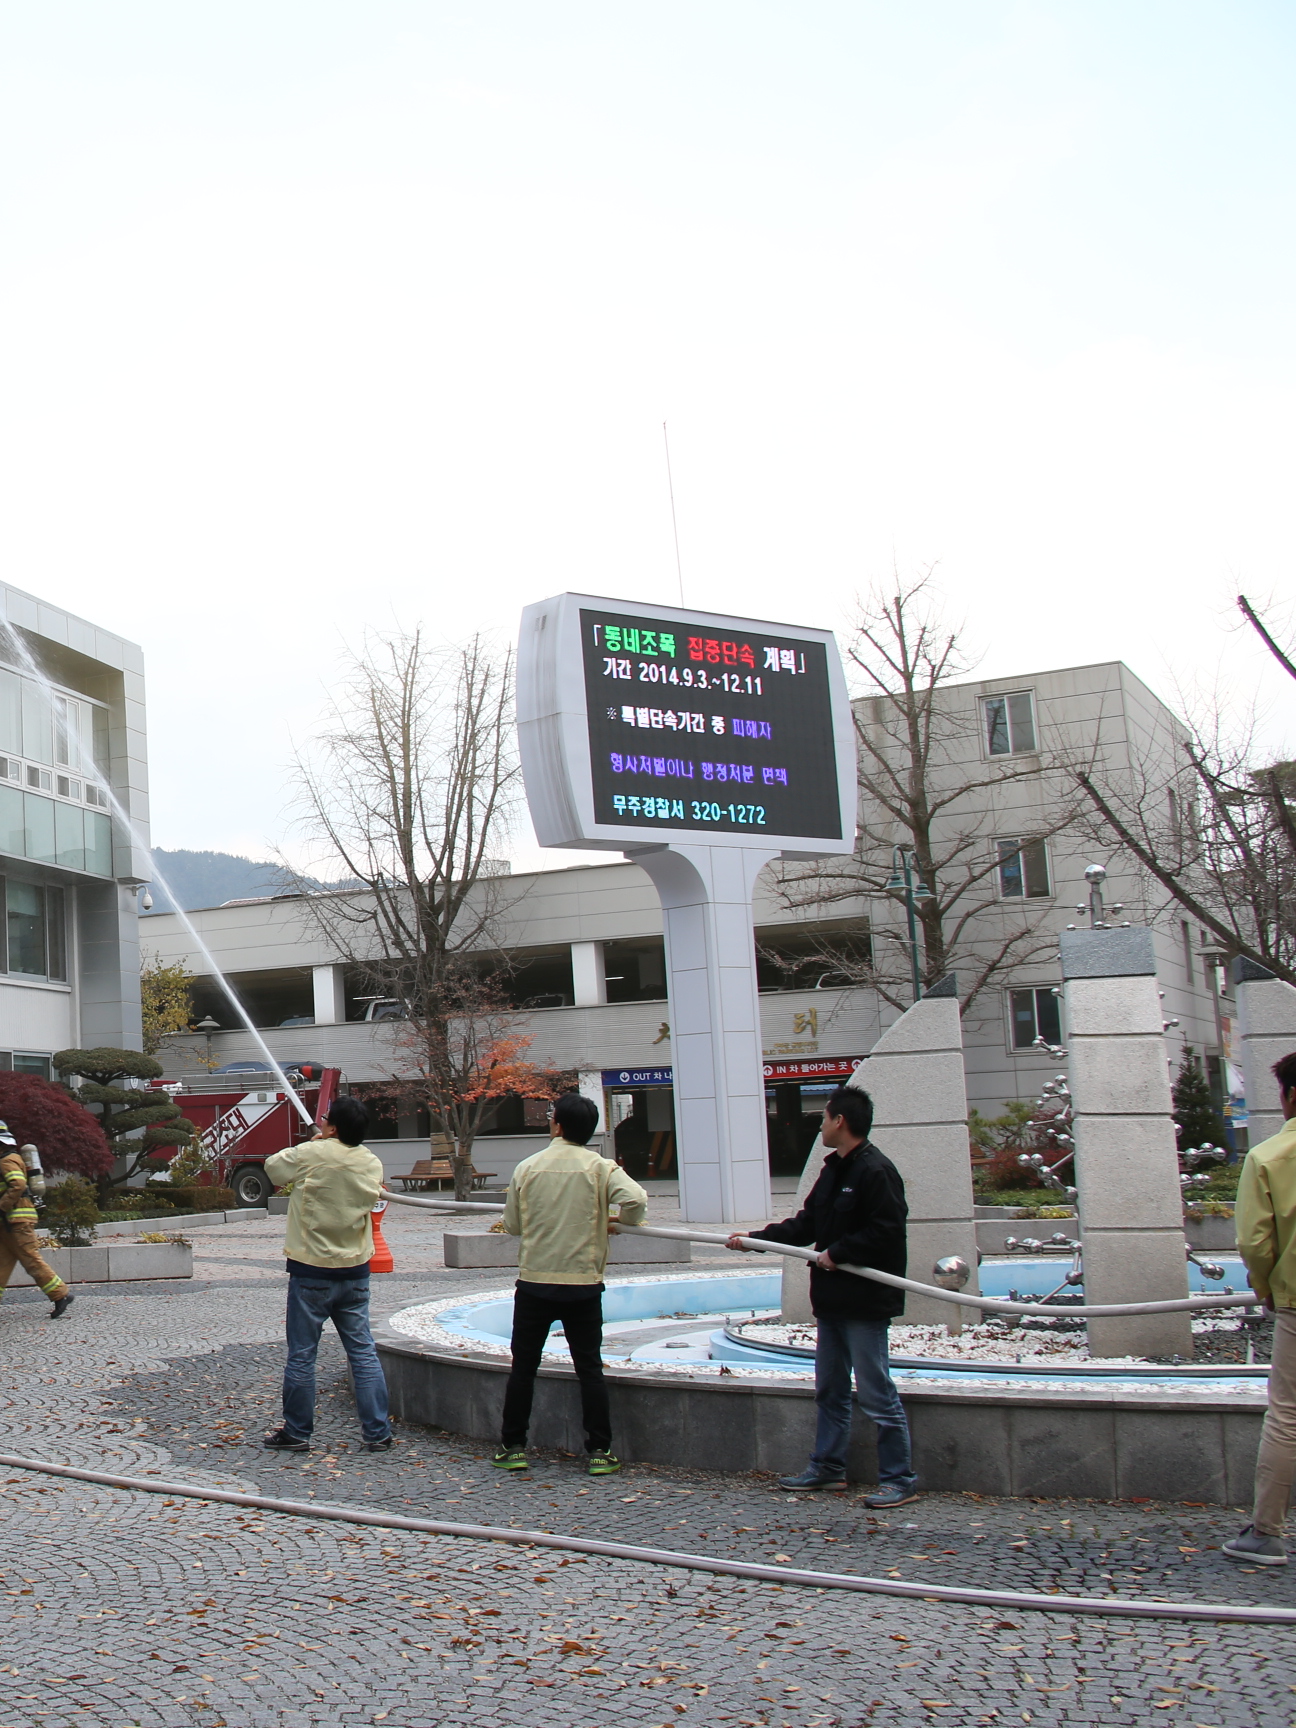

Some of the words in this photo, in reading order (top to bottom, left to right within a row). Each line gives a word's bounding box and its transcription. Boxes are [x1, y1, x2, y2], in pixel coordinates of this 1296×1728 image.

[688, 637, 755, 668] 집중단속
[603, 657, 632, 680] 기간
[639, 663, 763, 695] 2014.9.3.~12.11
[622, 706, 705, 733] 특별단속기간
[711, 715, 726, 736] 중
[732, 718, 772, 740] 피해자
[762, 766, 788, 786] 면책
[613, 795, 684, 819] 무주경찰서
[692, 801, 766, 825] 320-1272
[632, 1072, 652, 1081] OUT
[653, 1071, 663, 1081] 차
[776, 1065, 787, 1074] IN
[789, 1064, 799, 1074] 차
[801, 1062, 836, 1073] 들어가는
[838, 1061, 848, 1070] 곳
